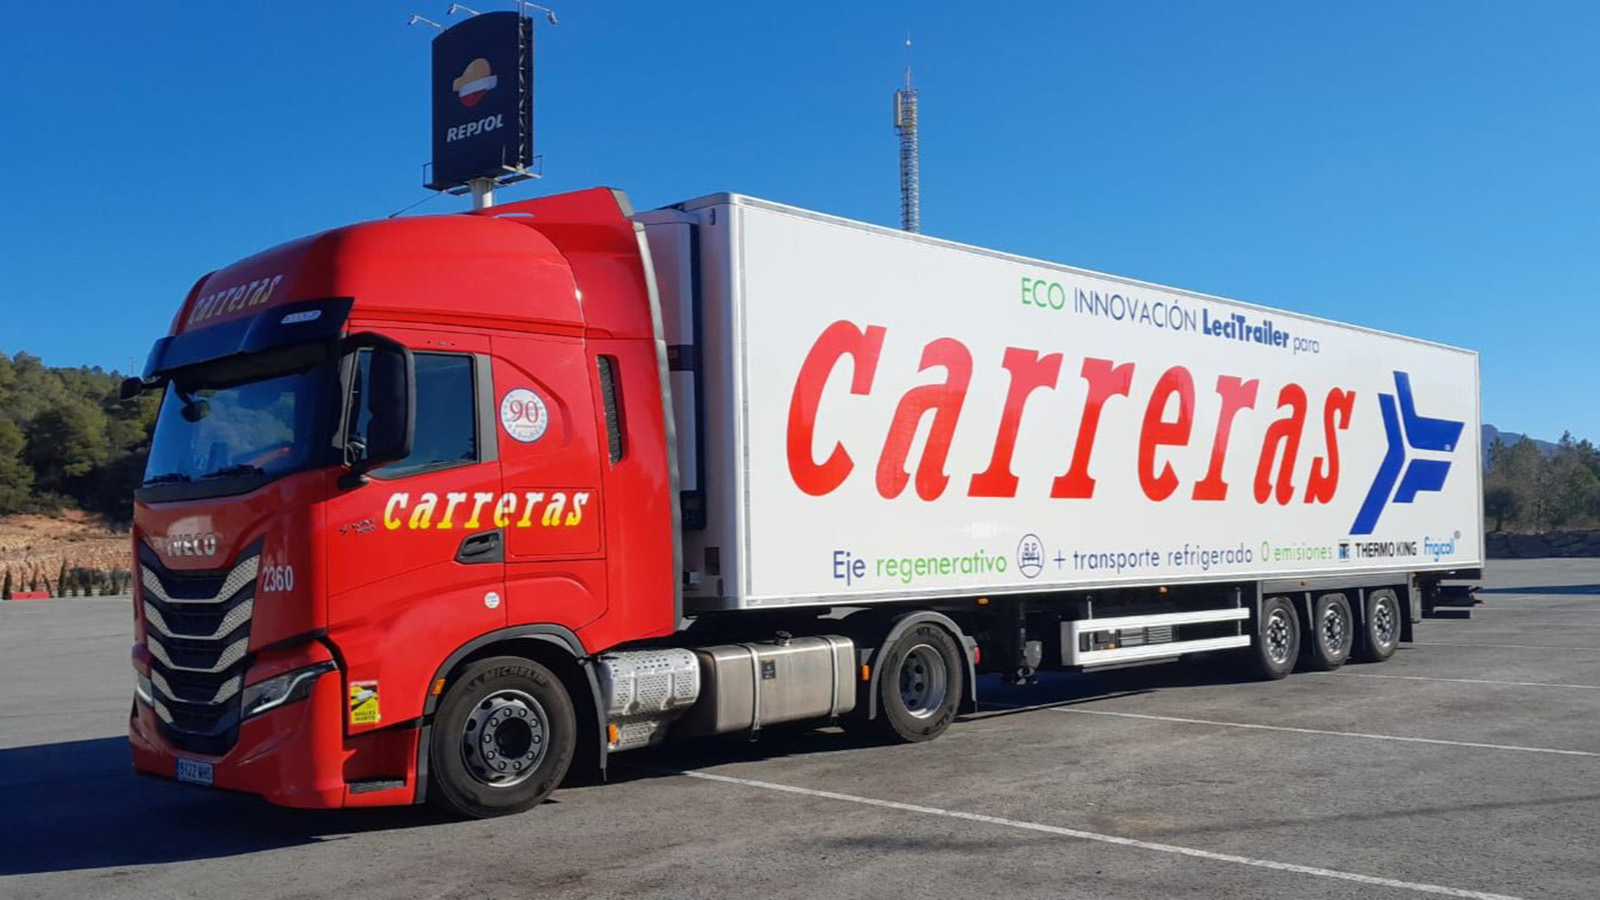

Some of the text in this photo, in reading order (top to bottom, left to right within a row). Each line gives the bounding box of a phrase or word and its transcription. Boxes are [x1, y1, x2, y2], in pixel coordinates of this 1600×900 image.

[446, 113, 504, 142] REPSOL
[1021, 277, 1320, 355] ECO INNOVACIÓN LeciTrailer para
[509, 400, 539, 423] 90
[786, 319, 1356, 506] carreras
[383, 492, 590, 530] carreras
[167, 533, 217, 557] IVECO
[1355, 541, 1418, 559] THERMO KING
[262, 565, 294, 592] 2360
[832, 550, 866, 586] Eje
[876, 549, 1008, 583] regenerativo
[1074, 548, 1160, 574] transporte
[1168, 543, 1253, 571] refrigerado
[1274, 542, 1332, 562] emisiones
